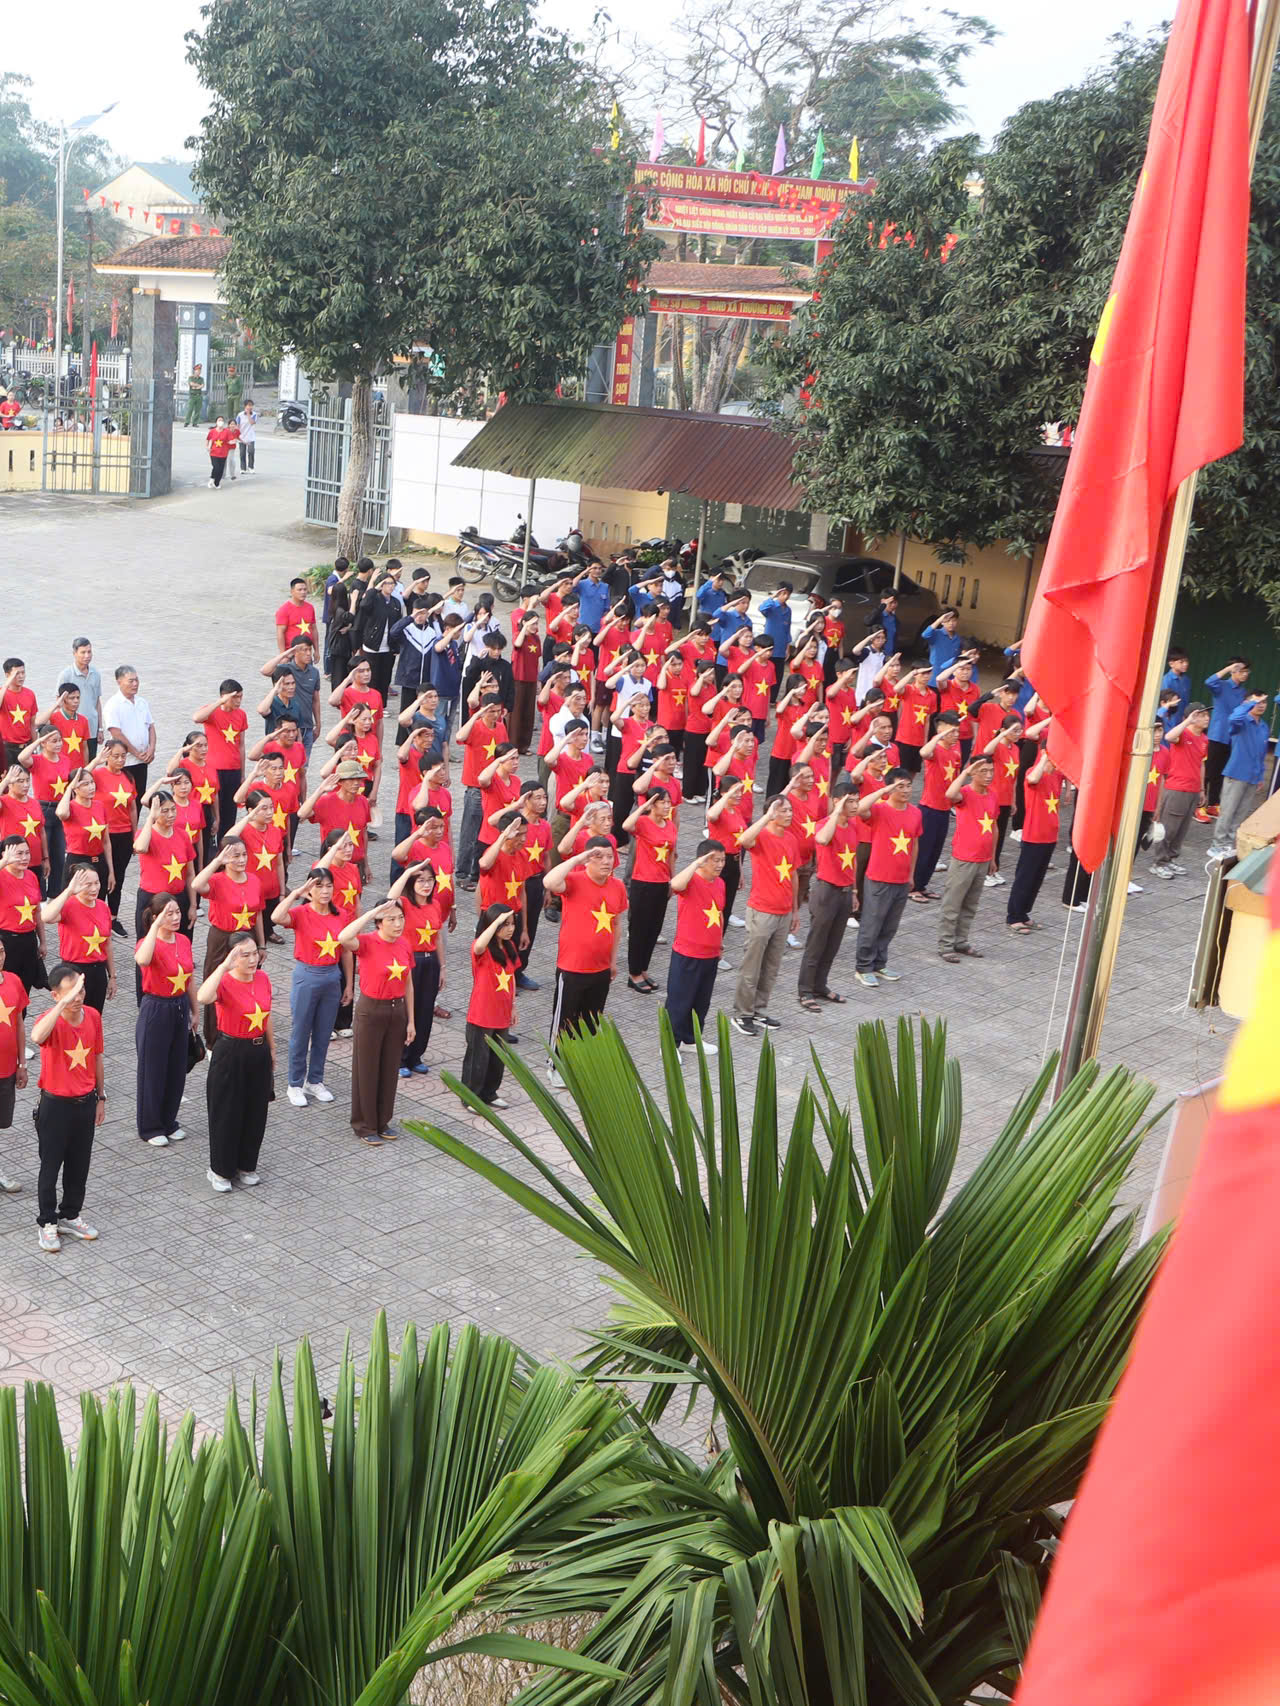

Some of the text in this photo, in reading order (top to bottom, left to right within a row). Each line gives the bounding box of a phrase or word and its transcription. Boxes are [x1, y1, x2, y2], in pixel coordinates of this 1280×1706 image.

[660, 169, 684, 191] CỘNG
[685, 172, 703, 191] HÒA
[704, 174, 717, 192] XÃ
[718, 175, 732, 196] HỘI
[733, 176, 750, 195] CHỦ
[796, 185, 814, 201] NAM
[815, 185, 837, 202] MUÔN
[838, 186, 858, 203] NĂ
